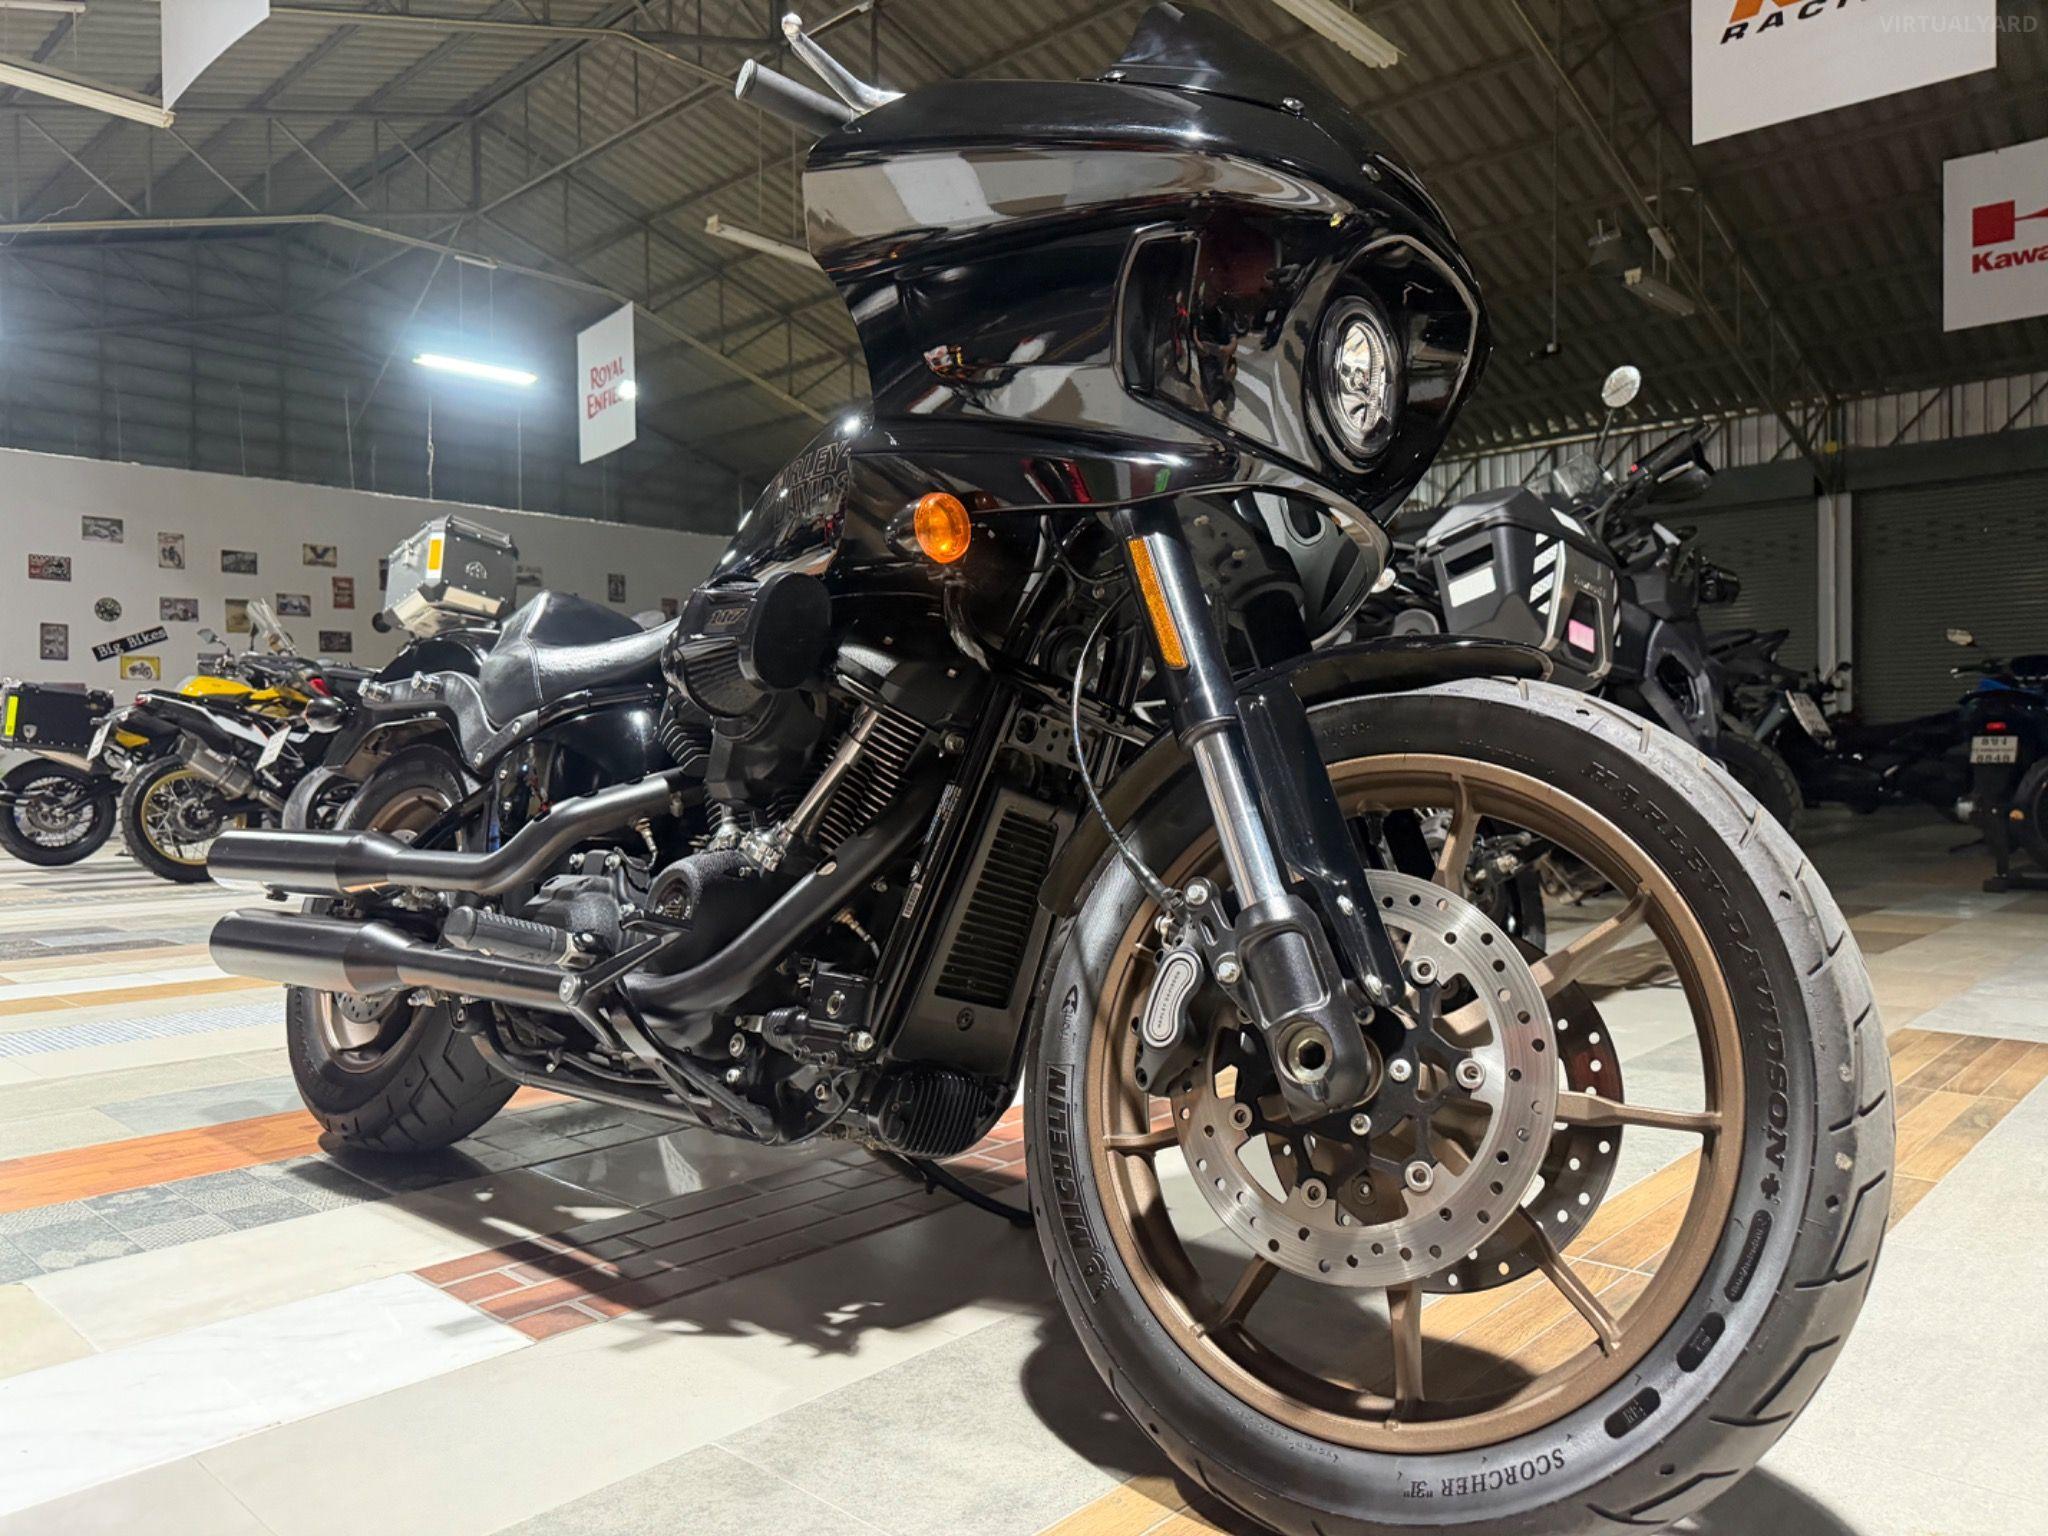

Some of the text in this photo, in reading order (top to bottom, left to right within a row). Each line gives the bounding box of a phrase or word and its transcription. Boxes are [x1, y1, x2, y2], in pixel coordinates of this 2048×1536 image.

[1720, 0, 1867, 45] RAC
[590, 356, 624, 390] ROYAL
[1047, 1064, 1095, 1250] MICHELIN
[1441, 1448, 1566, 1497] SCORCHER
